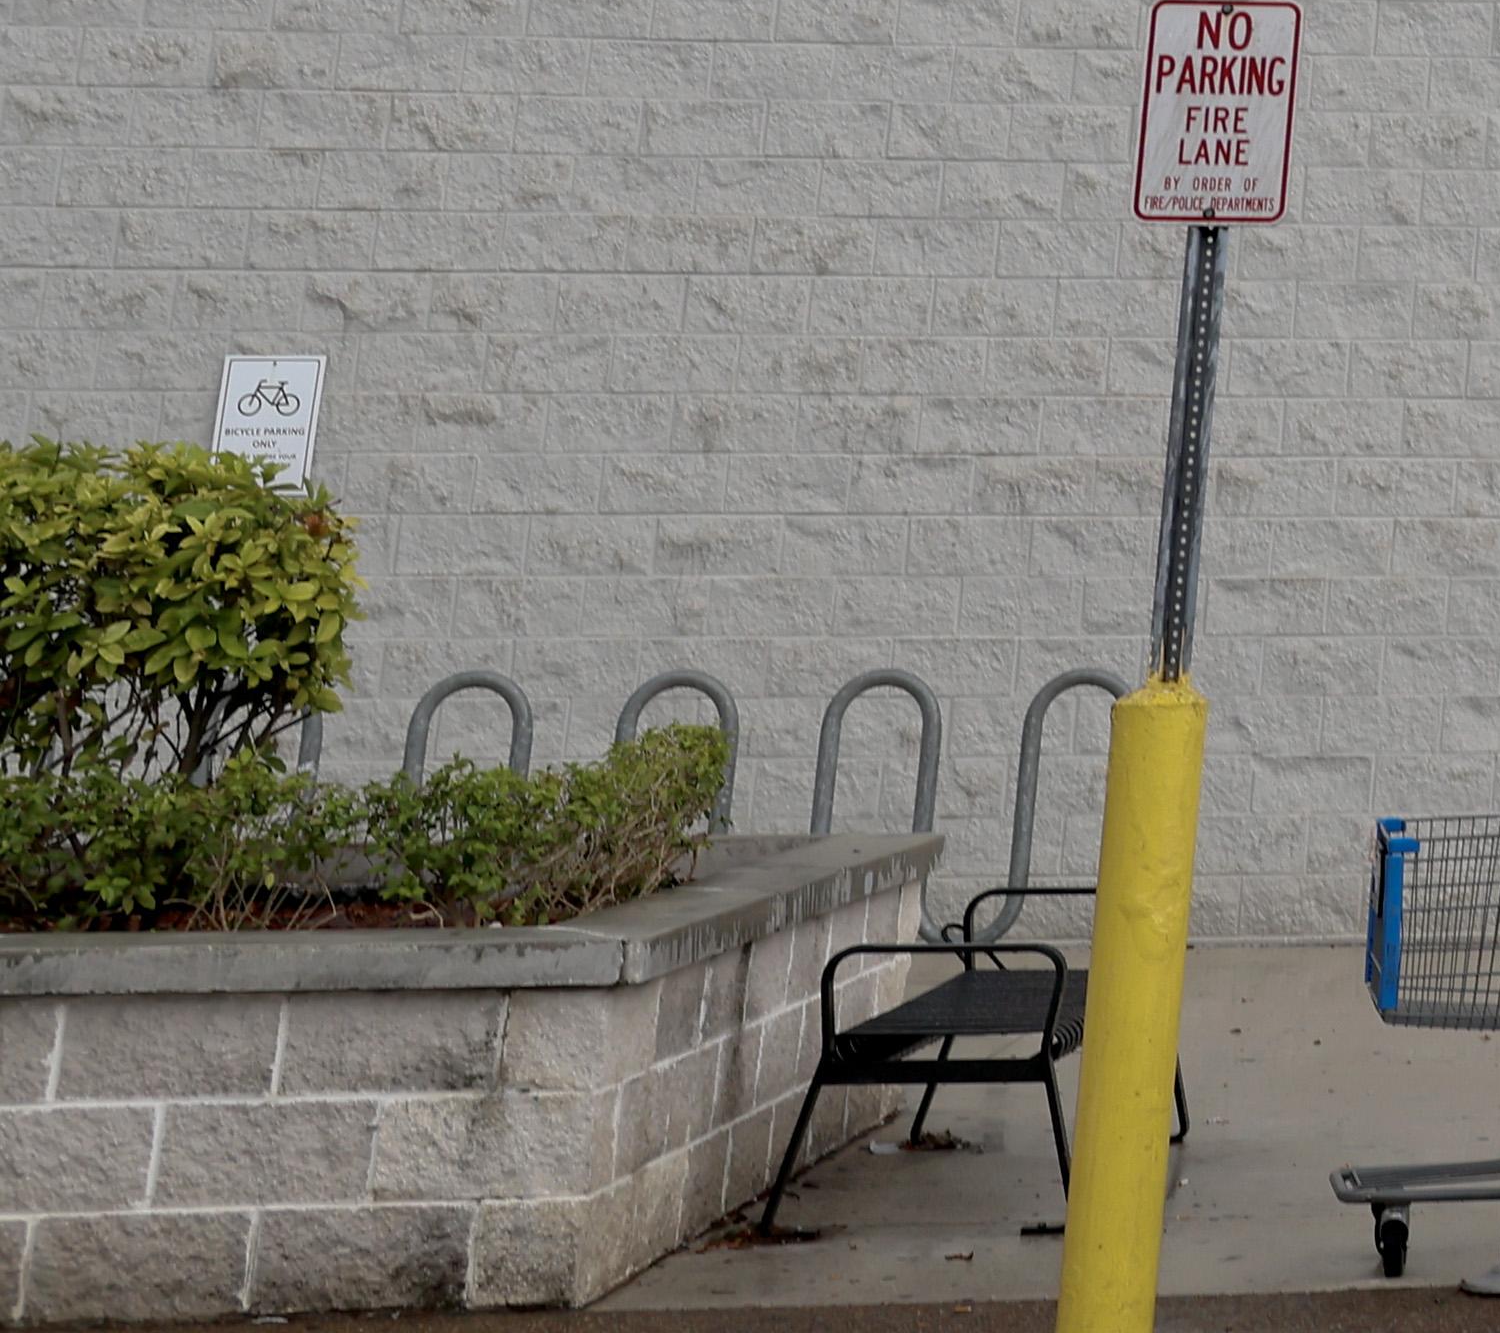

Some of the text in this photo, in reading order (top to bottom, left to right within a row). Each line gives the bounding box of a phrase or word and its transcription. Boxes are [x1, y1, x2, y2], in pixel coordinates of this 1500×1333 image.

[1197, 11, 1253, 50] NO
[1156, 55, 1286, 96] PARKING
[1186, 107, 1249, 134] FIRE
[1178, 138, 1250, 166] LANE
[1164, 177, 1258, 192] BY ORDER OF
[1144, 196, 1275, 212] FIRE/POLICE DEPARTMENTS
[225, 428, 305, 437] BICYCLE PARKING
[252, 440, 277, 448] ONLY
